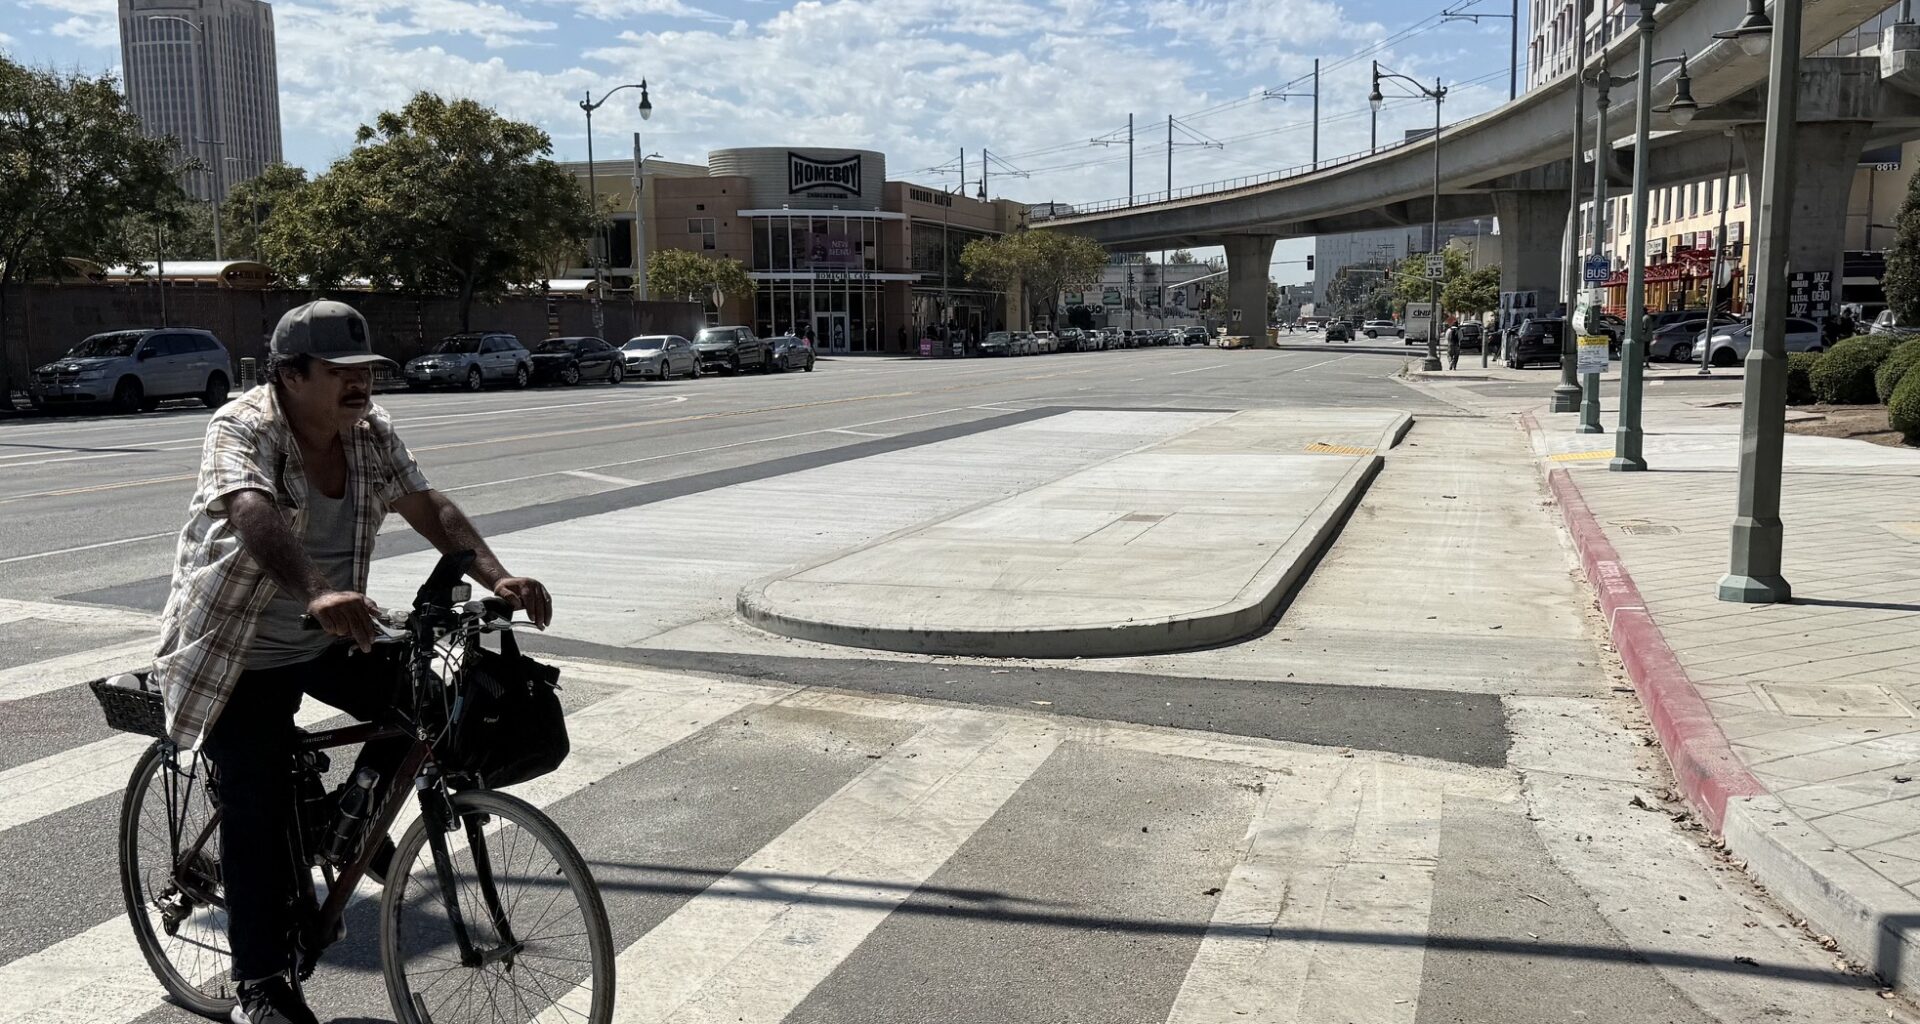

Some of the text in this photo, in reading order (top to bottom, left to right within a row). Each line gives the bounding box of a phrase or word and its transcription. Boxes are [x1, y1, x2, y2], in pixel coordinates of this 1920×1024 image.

[794, 161, 857, 188] HOMEBOY
[831, 240, 849, 248] NEW
[1427, 267, 1442, 277] 35
[1586, 268, 1607, 279] BUS
[1813, 271, 1830, 283] JAZZ
[1818, 282, 1824, 290] IS
[1811, 290, 1830, 301] DEAD
[1791, 303, 1807, 313] JAZZ
